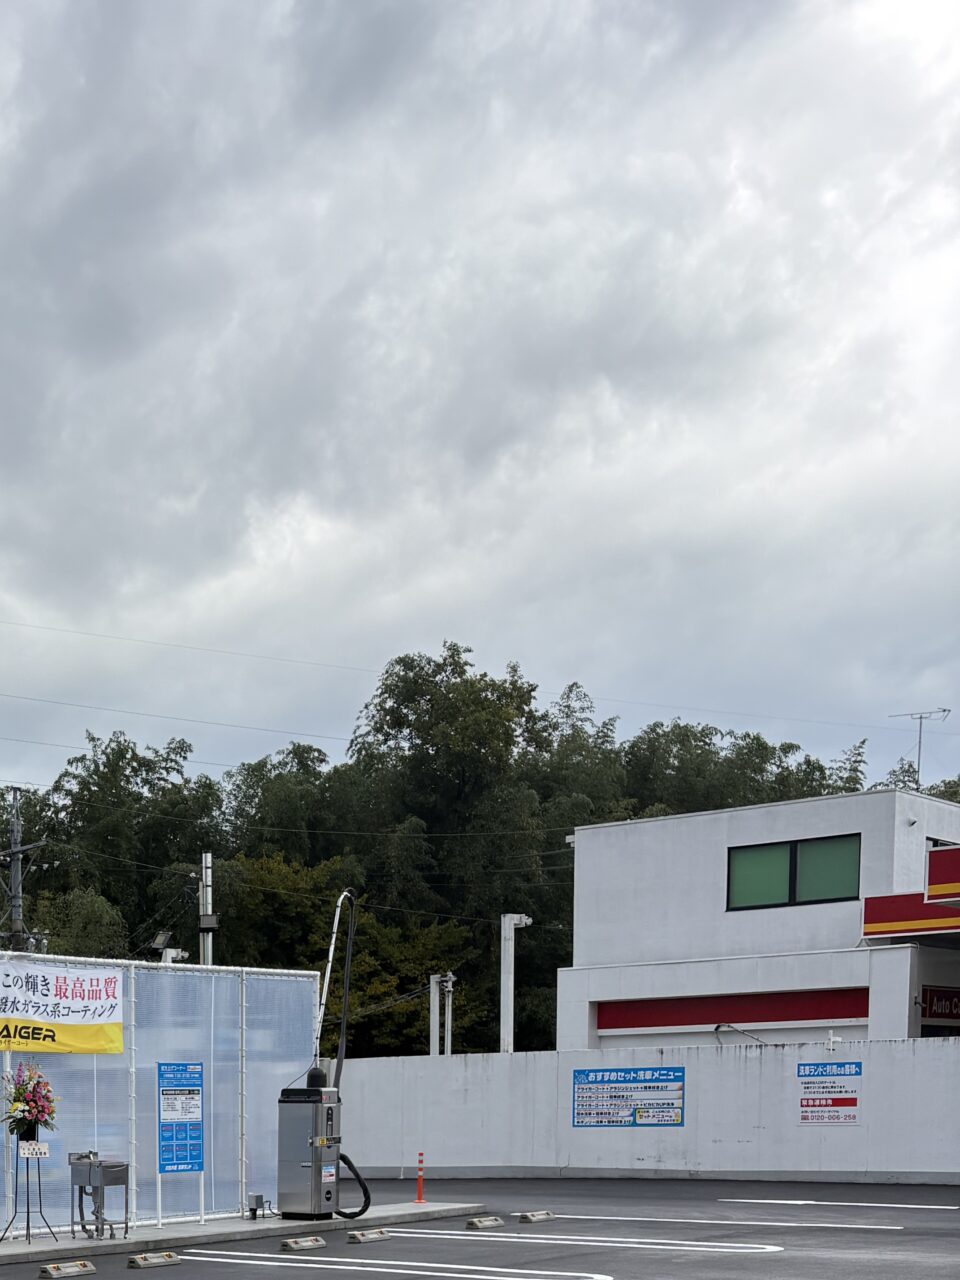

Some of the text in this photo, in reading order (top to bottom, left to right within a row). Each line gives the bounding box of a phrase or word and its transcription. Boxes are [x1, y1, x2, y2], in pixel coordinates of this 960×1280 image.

[932, 996, 950, 1014] Auto
[588, 1070, 683, 1081] おすすめセット洗車メニュー
[799, 1064, 860, 1076] 洗車ランドご利用のお客様へ
